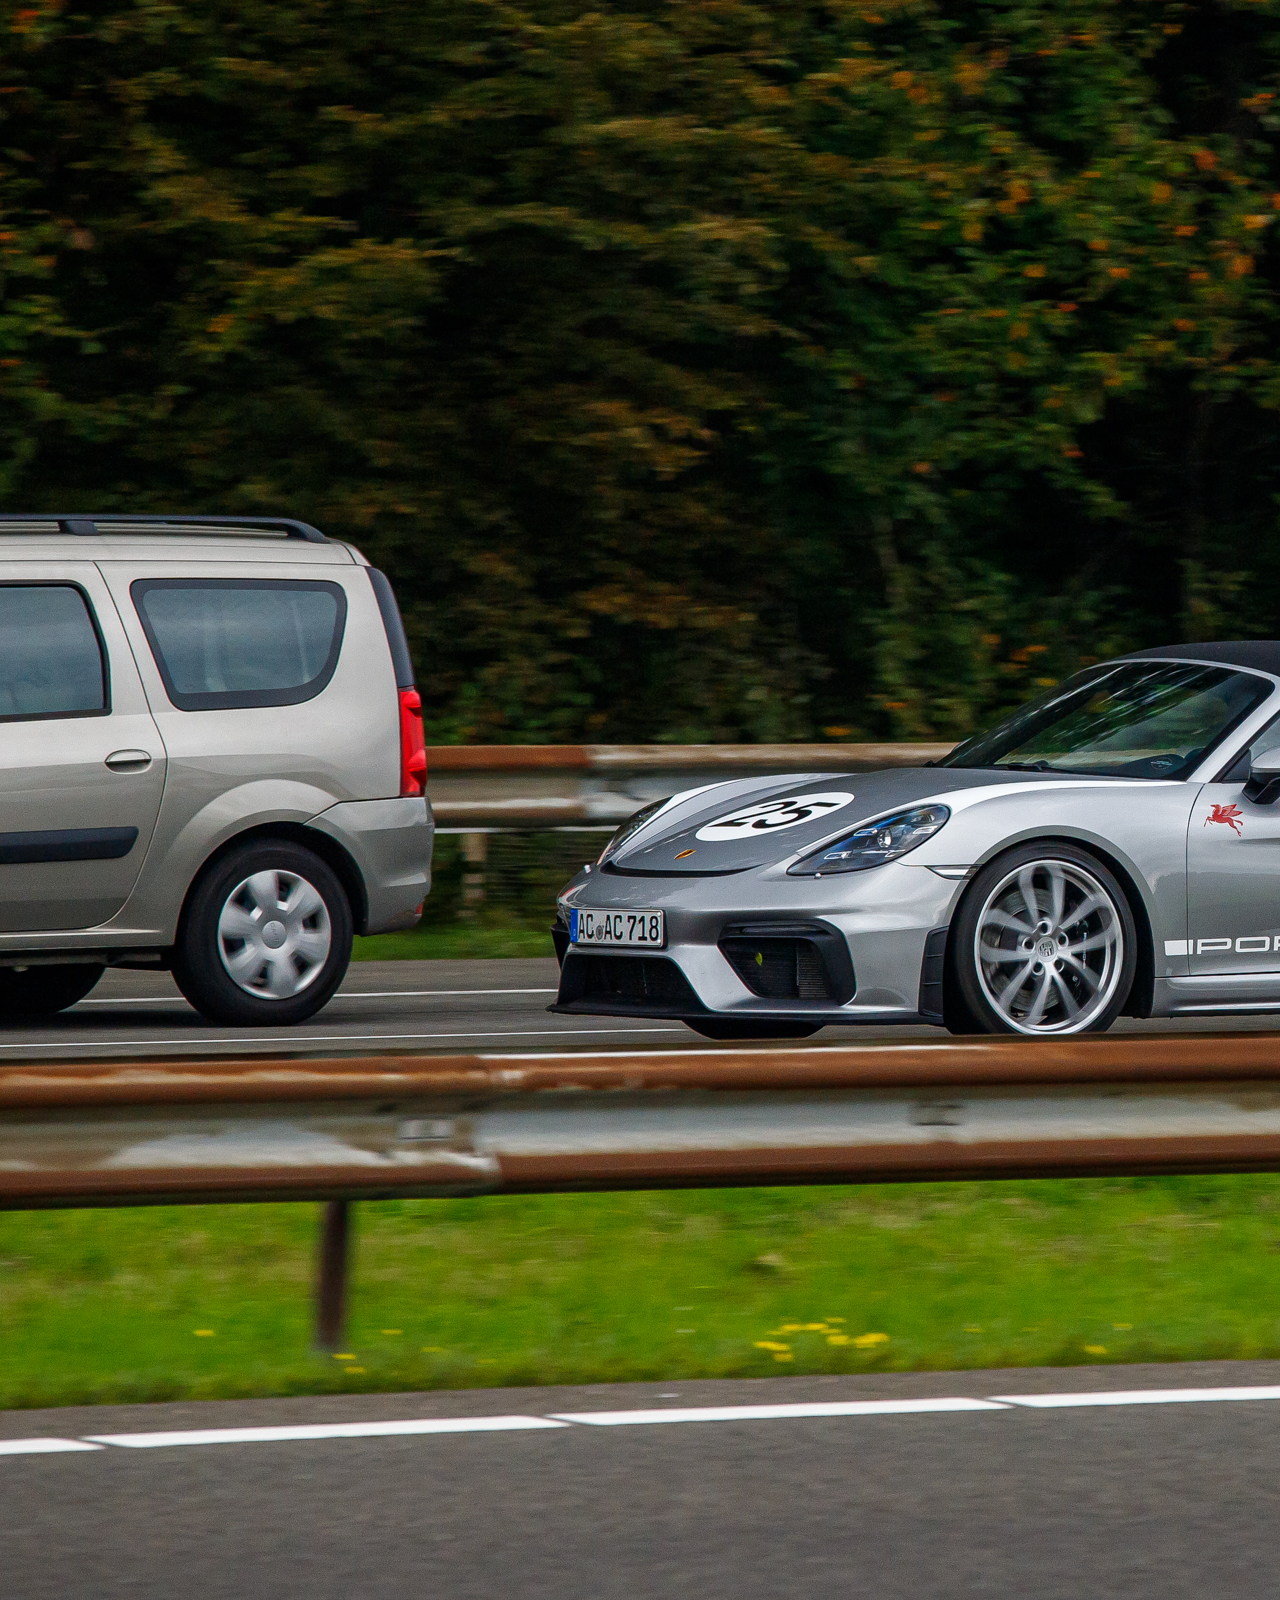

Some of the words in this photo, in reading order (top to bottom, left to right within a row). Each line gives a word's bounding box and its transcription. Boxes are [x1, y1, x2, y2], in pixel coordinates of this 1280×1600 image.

[707, 801, 841, 829] 25
[578, 913, 594, 939] AC
[604, 914, 623, 941] AC
[627, 915, 659, 941] 718
